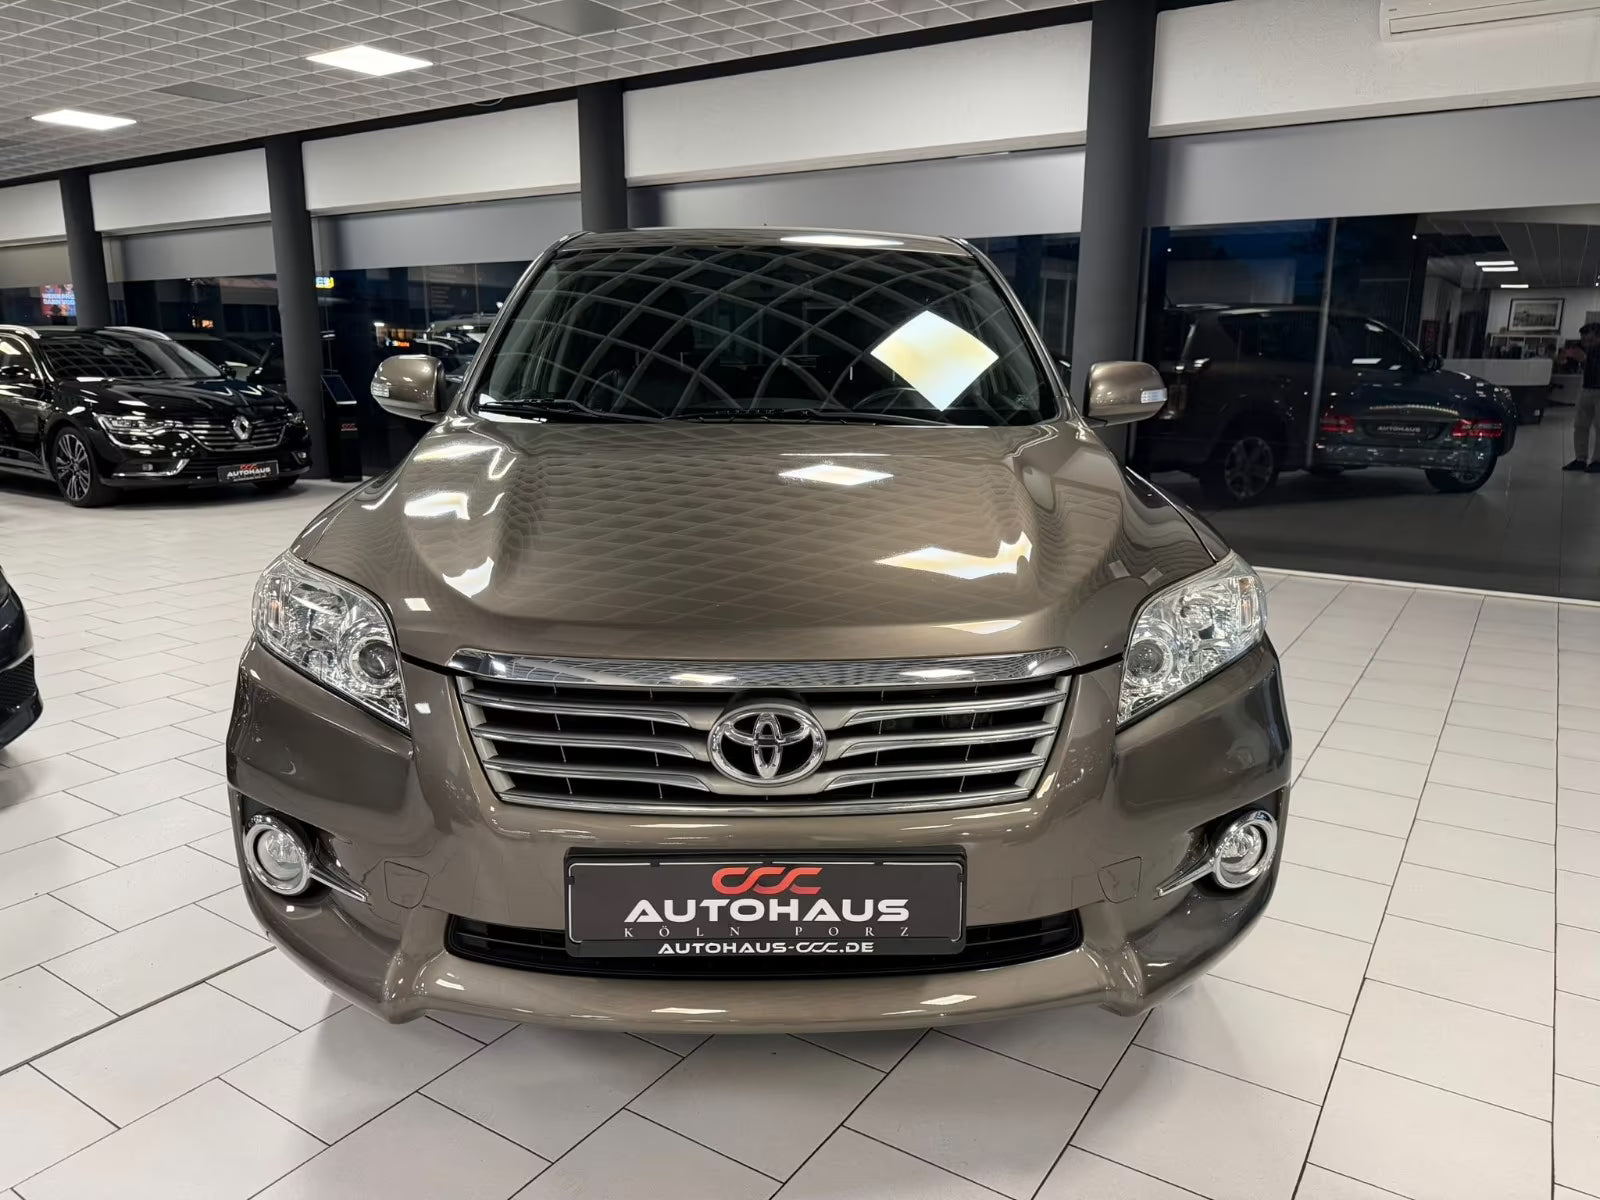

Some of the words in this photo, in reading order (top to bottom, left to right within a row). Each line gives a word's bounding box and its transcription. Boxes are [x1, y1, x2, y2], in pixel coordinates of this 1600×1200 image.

[226, 467, 271, 477] AUTOHAUS
[623, 898, 910, 923] AUTOHAUS
[624, 925, 741, 937] KÖLN
[795, 926, 909, 937] PORZ
[657, 942, 875, 954] AUTOHAUS-CCC.DE
